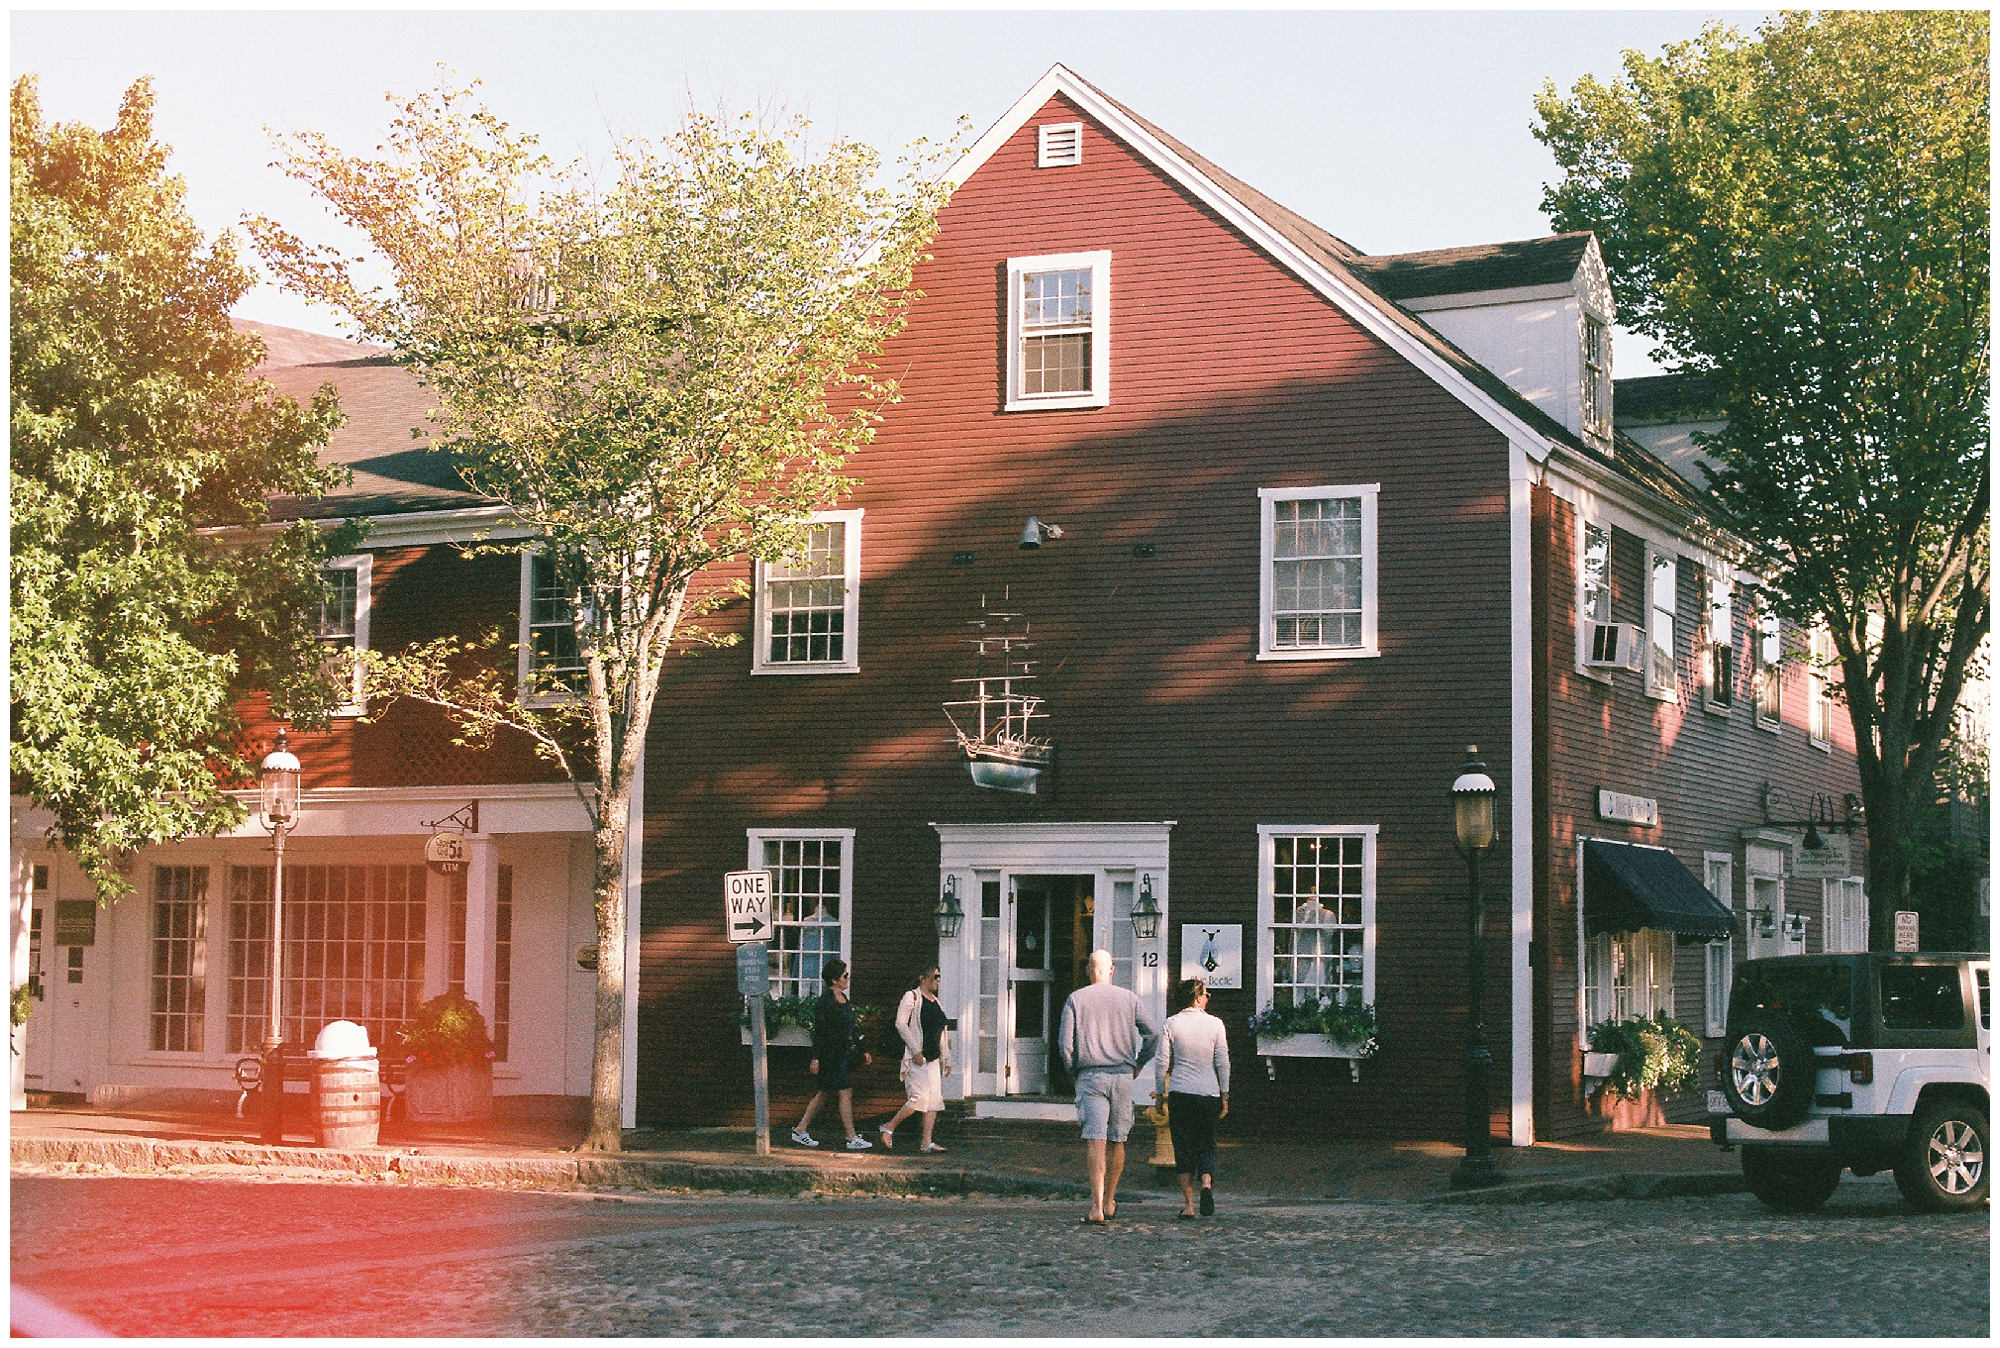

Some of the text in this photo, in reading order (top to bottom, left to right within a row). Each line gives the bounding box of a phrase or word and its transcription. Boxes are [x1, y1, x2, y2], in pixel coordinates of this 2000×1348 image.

[441, 862, 459, 872] ATM
[732, 878, 766, 895] ONE
[731, 896, 767, 914] WAY
[1142, 952, 1158, 967] 12
[1208, 975, 1233, 986] Beetle
